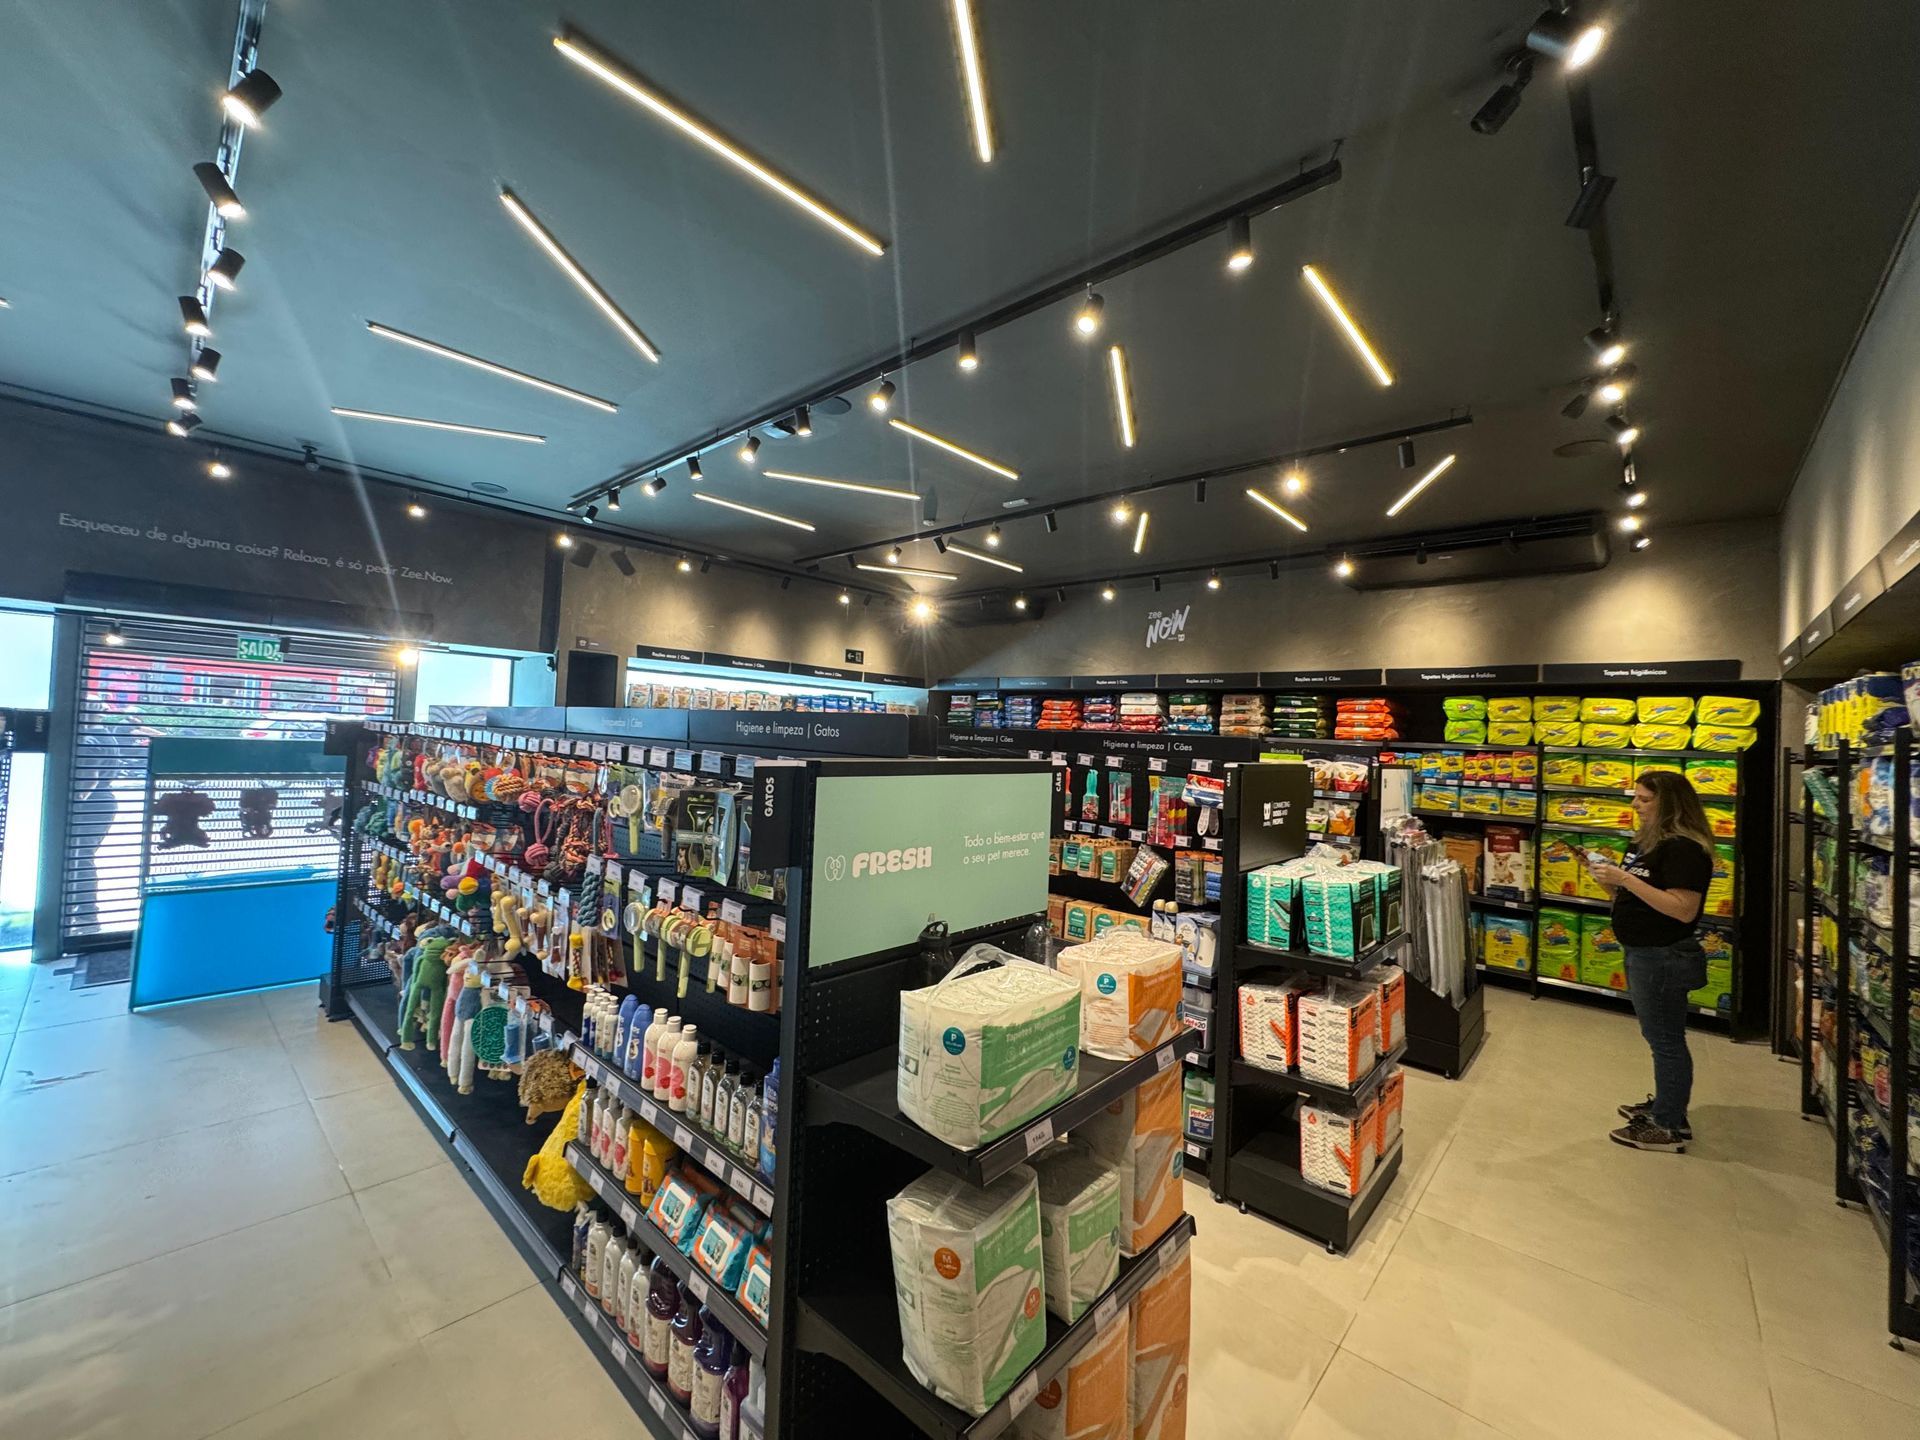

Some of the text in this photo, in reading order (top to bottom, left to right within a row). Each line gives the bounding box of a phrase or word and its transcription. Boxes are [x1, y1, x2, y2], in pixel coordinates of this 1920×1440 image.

[58, 512, 140, 537] Esqueceu
[145, 526, 168, 541] de
[172, 531, 231, 549] alguma
[235, 542, 279, 558] coisa?
[283, 548, 331, 568] Relaxa,
[335, 557, 344, 568] é
[348, 559, 362, 571] só
[365, 563, 398, 575] pedir
[1146, 604, 1191, 648] NOW
[736, 721, 764, 735] Higiene
[765, 723, 771, 734] e
[773, 722, 803, 738] limpeza
[814, 723, 840, 737] Gatos
[950, 734, 968, 742] Higiene
[974, 734, 994, 743] limpeza
[1103, 740, 1129, 749] Higiene
[1137, 741, 1164, 751] limpeza
[1173, 742, 1193, 751] Cães
[764, 776, 775, 817] GATOS
[964, 831, 1045, 848] Todo o bem-estar que
[852, 846, 932, 878] FRESH
[963, 856, 969, 865] o
[971, 854, 986, 864] seu
[987, 850, 1000, 864] pet
[951, 1033, 957, 1041] P
